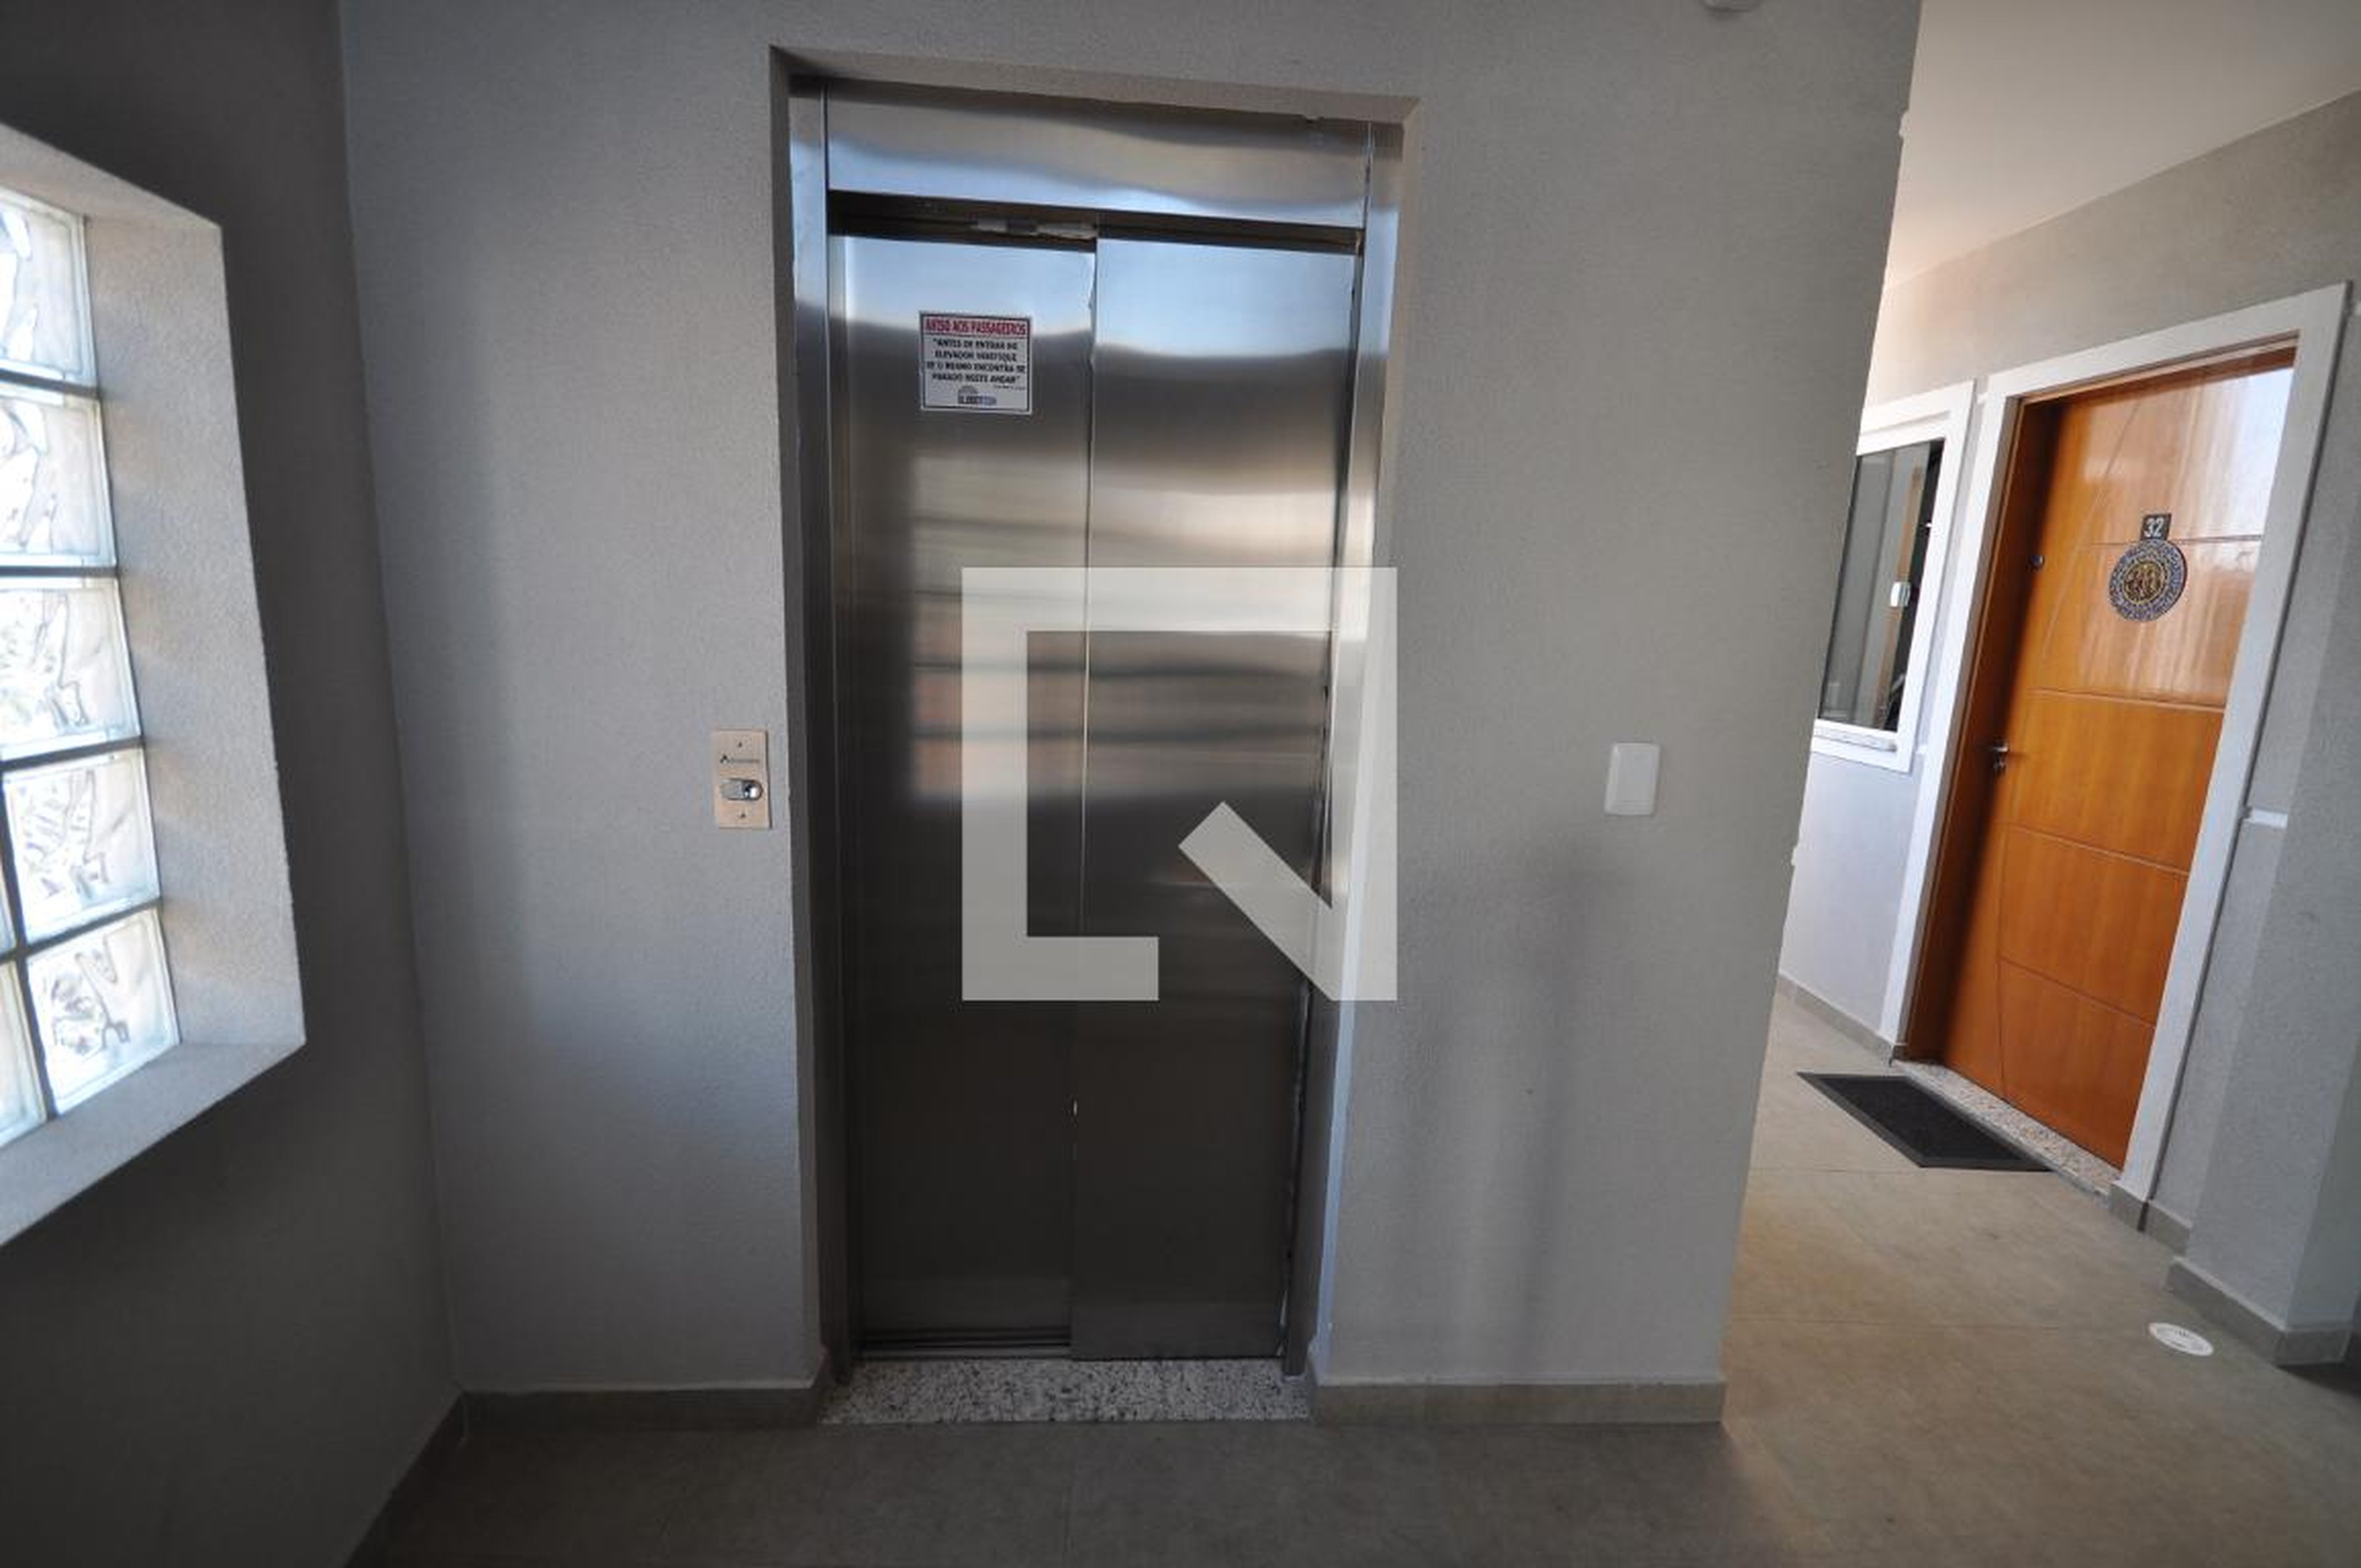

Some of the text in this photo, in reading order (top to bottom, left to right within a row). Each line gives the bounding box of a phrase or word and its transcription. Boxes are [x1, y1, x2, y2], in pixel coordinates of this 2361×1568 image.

[926, 319, 1026, 335] AVISO AOS PASSAGEIROS
[2144, 517, 2164, 538] 32
